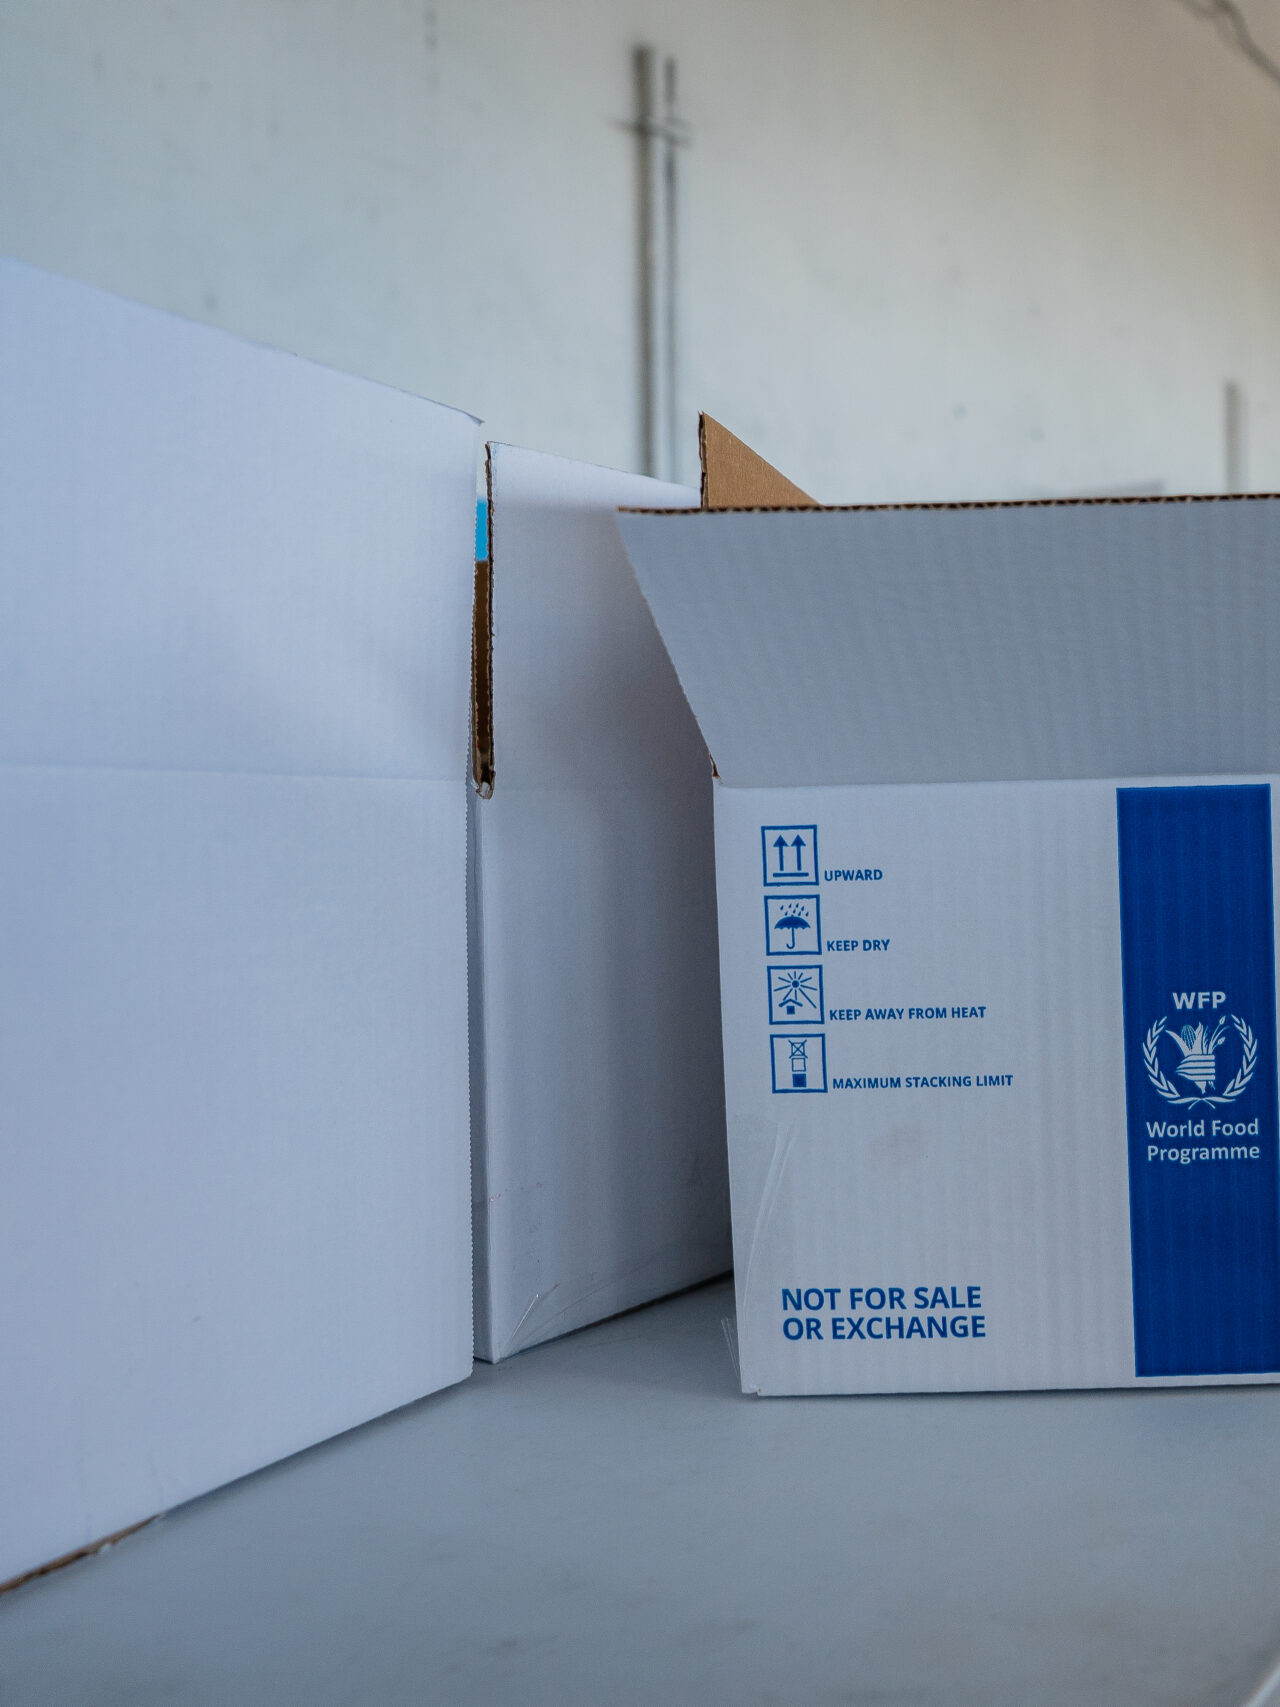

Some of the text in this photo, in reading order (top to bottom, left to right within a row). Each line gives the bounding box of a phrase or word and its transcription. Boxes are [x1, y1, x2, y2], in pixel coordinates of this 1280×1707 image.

[824, 868, 882, 881] UPWARD
[826, 938, 890, 951] KEEP DRY
[1172, 991, 1225, 1009] WFP
[829, 1005, 986, 1020] KEEP AWAY FROM HEAT
[832, 1074, 1013, 1088] MAXIMUM STACKING LIMIT
[1145, 1117, 1258, 1137] World Food
[1147, 1144, 1259, 1164] Programme
[781, 1285, 981, 1310] NOT FOR SALE
[782, 1315, 986, 1340] OR EXCHANGE
